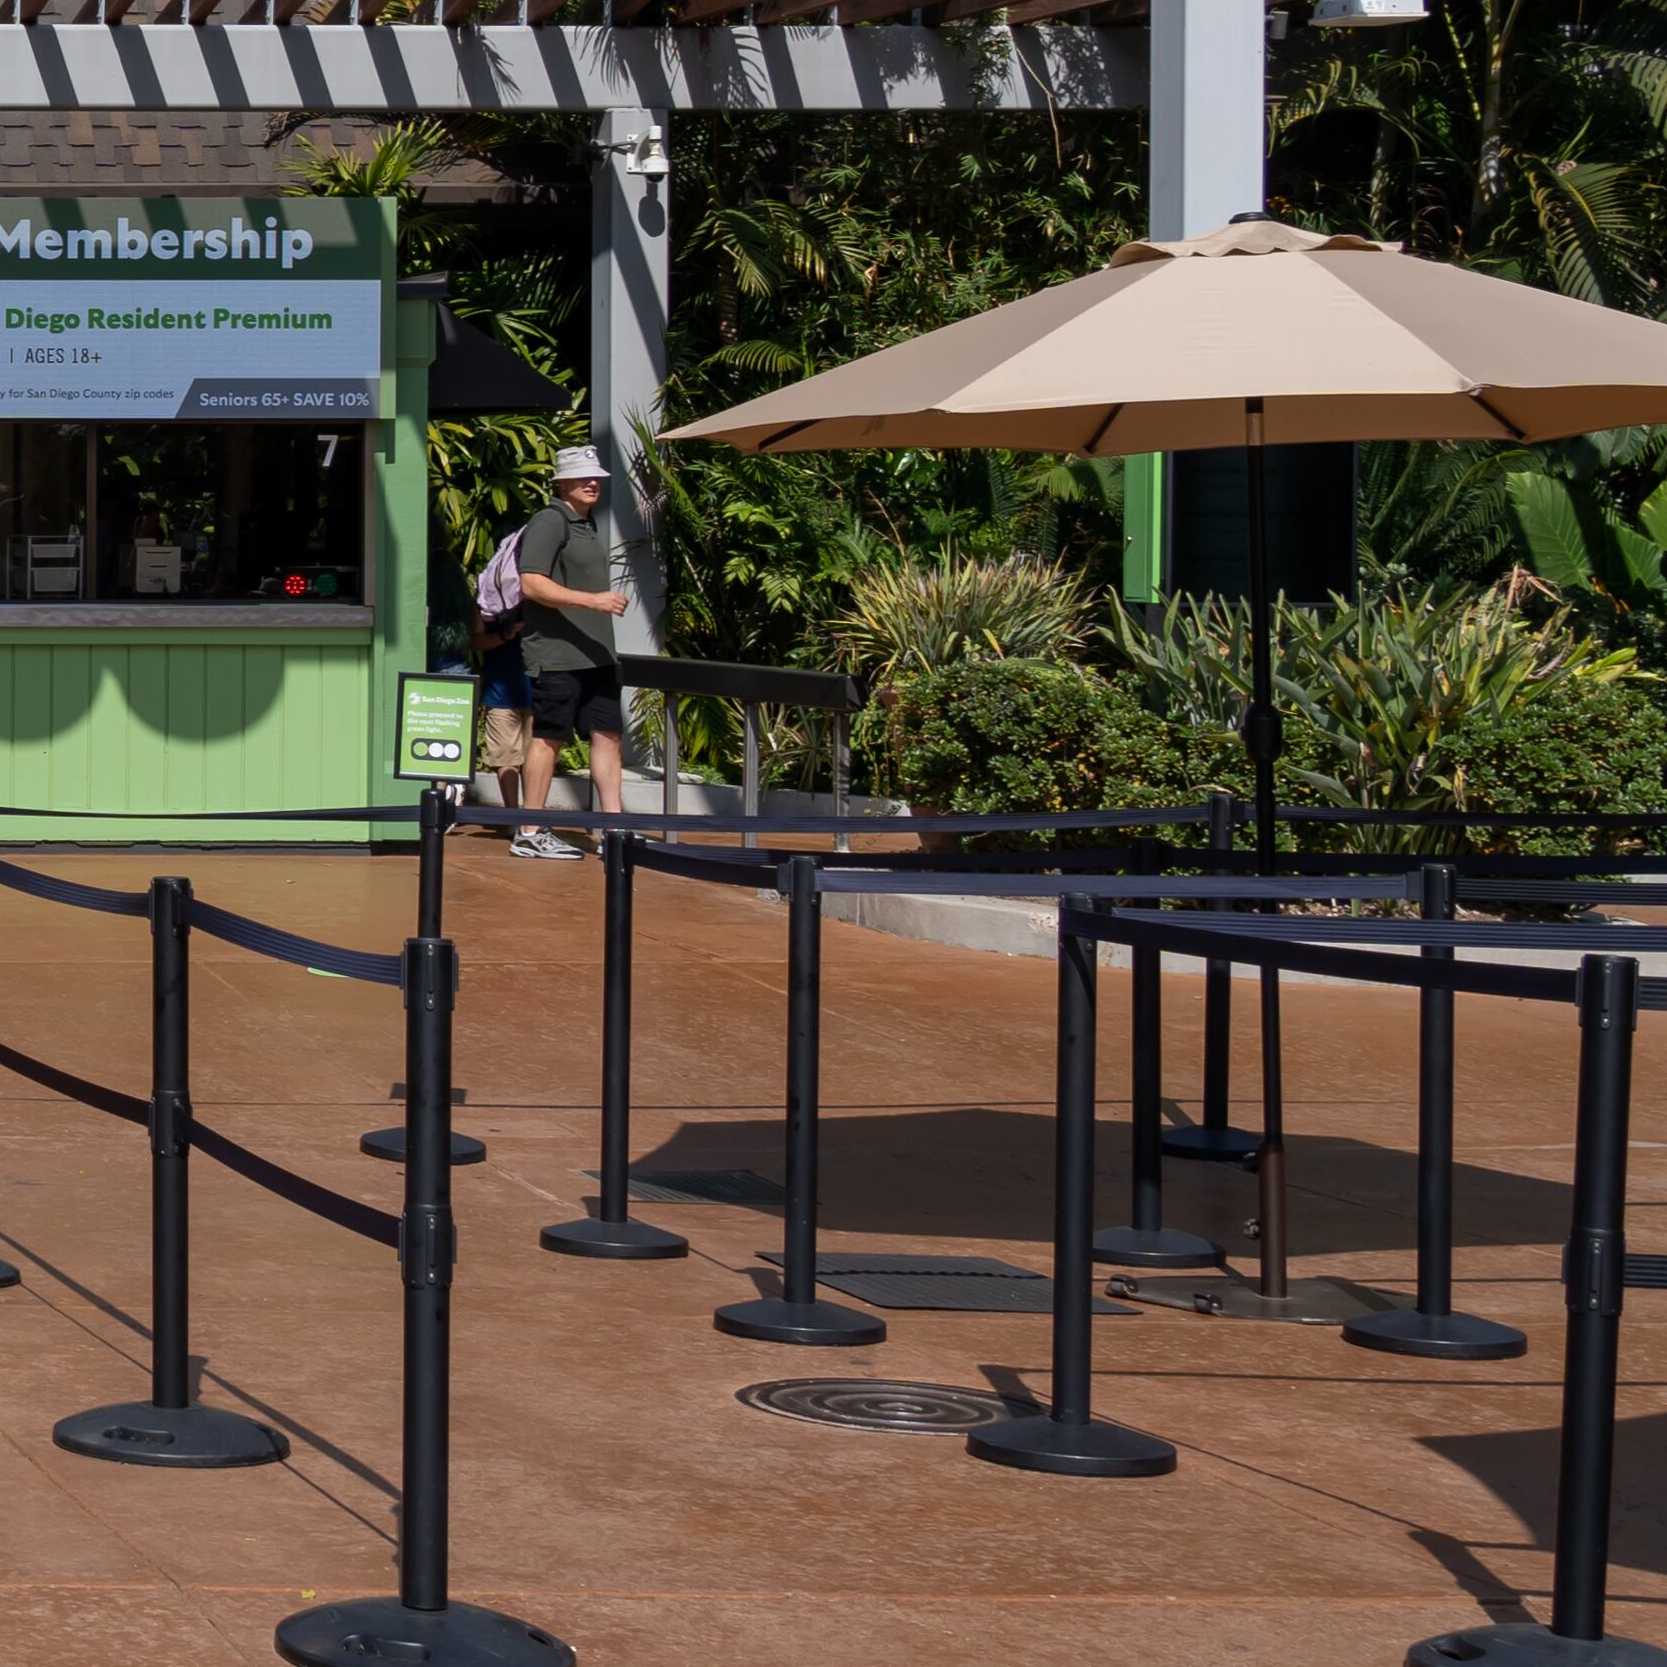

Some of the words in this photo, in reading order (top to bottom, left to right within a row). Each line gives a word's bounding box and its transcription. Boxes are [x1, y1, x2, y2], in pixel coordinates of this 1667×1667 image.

[5, 306, 81, 335] Diego
[87, 306, 207, 330] Resident
[213, 306, 334, 330] Premium
[24, 347, 65, 364] AGES
[71, 347, 103, 364] 18+
[8, 387, 25, 399] for
[26, 388, 47, 399] San
[49, 387, 81, 401] Diego
[82, 388, 122, 401] County
[124, 388, 141, 401] zip
[143, 387, 175, 399] codes
[198, 392, 258, 407] Seniors
[261, 392, 290, 407] 65+
[293, 392, 335, 407] SAVE
[338, 392, 370, 407] 10%
[317, 434, 339, 468] 7
